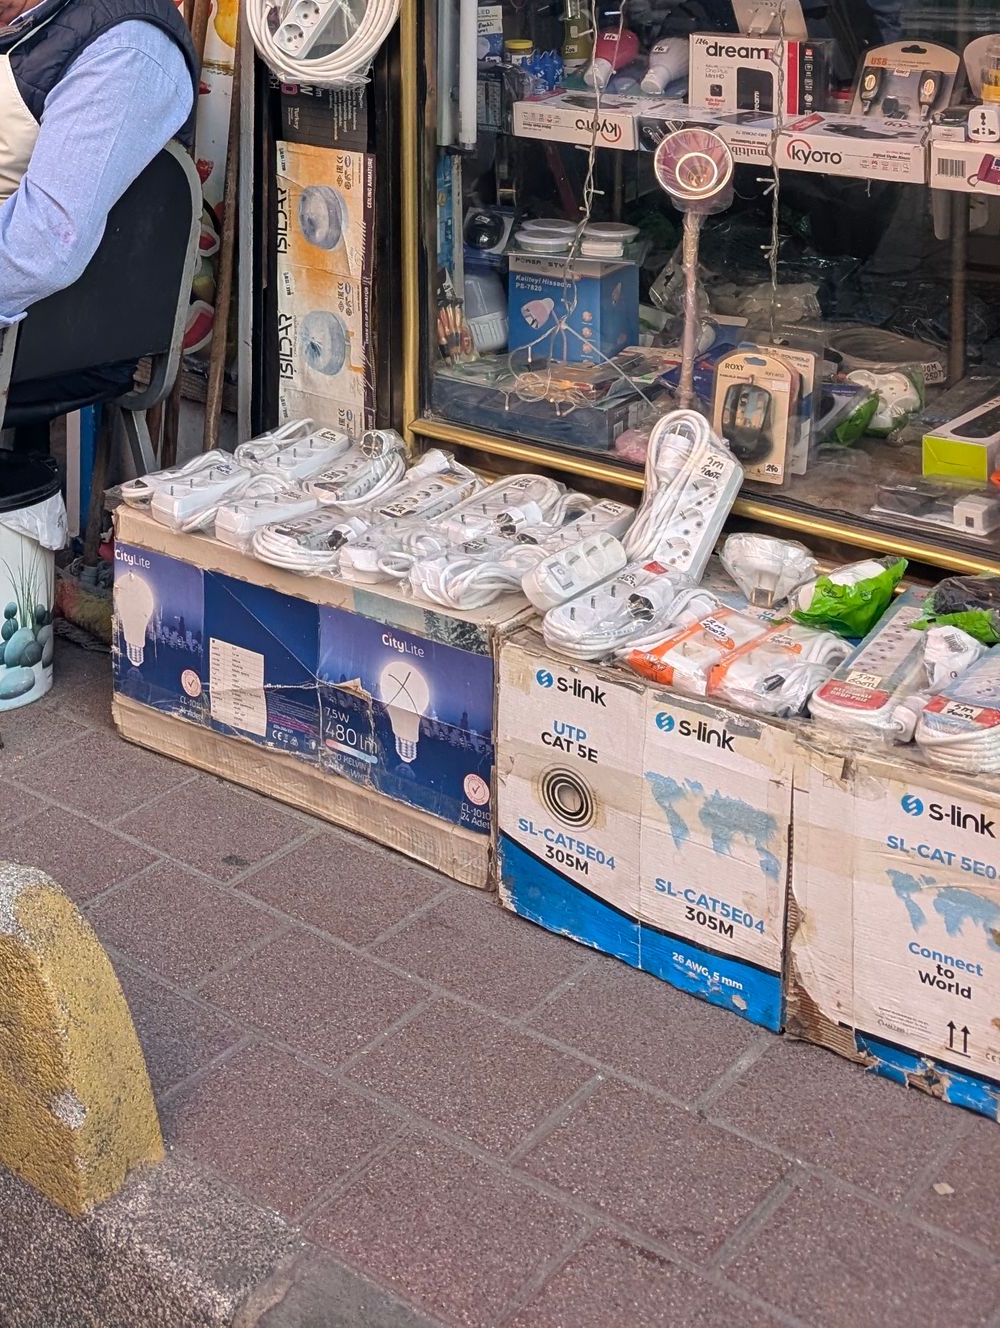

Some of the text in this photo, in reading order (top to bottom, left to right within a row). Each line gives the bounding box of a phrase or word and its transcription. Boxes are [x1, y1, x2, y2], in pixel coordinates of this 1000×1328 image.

[870, 57, 888, 66] USB
[542, 278, 572, 289] Hissedn
[724, 362, 744, 371] ROXY
[114, 548, 151, 569] CityLite
[381, 633, 425, 658] CityLite
[556, 673, 607, 708] s-link
[325, 723, 358, 746] 480
[553, 719, 588, 741] UTP
[677, 719, 736, 753] s-link
[540, 730, 598, 764] CAT 5E
[460, 811, 471, 822] 24
[928, 802, 997, 839] s-link
[517, 818, 617, 871] SL-CAT5E04
[544, 844, 590, 876] 305M
[886, 835, 1000, 881] SL-CAT 5E0
[653, 876, 767, 936] SL-CAT5E04
[684, 904, 735, 940] 305M
[907, 941, 984, 978] Connect
[935, 964, 955, 980] to
[918, 968, 972, 1000] World
